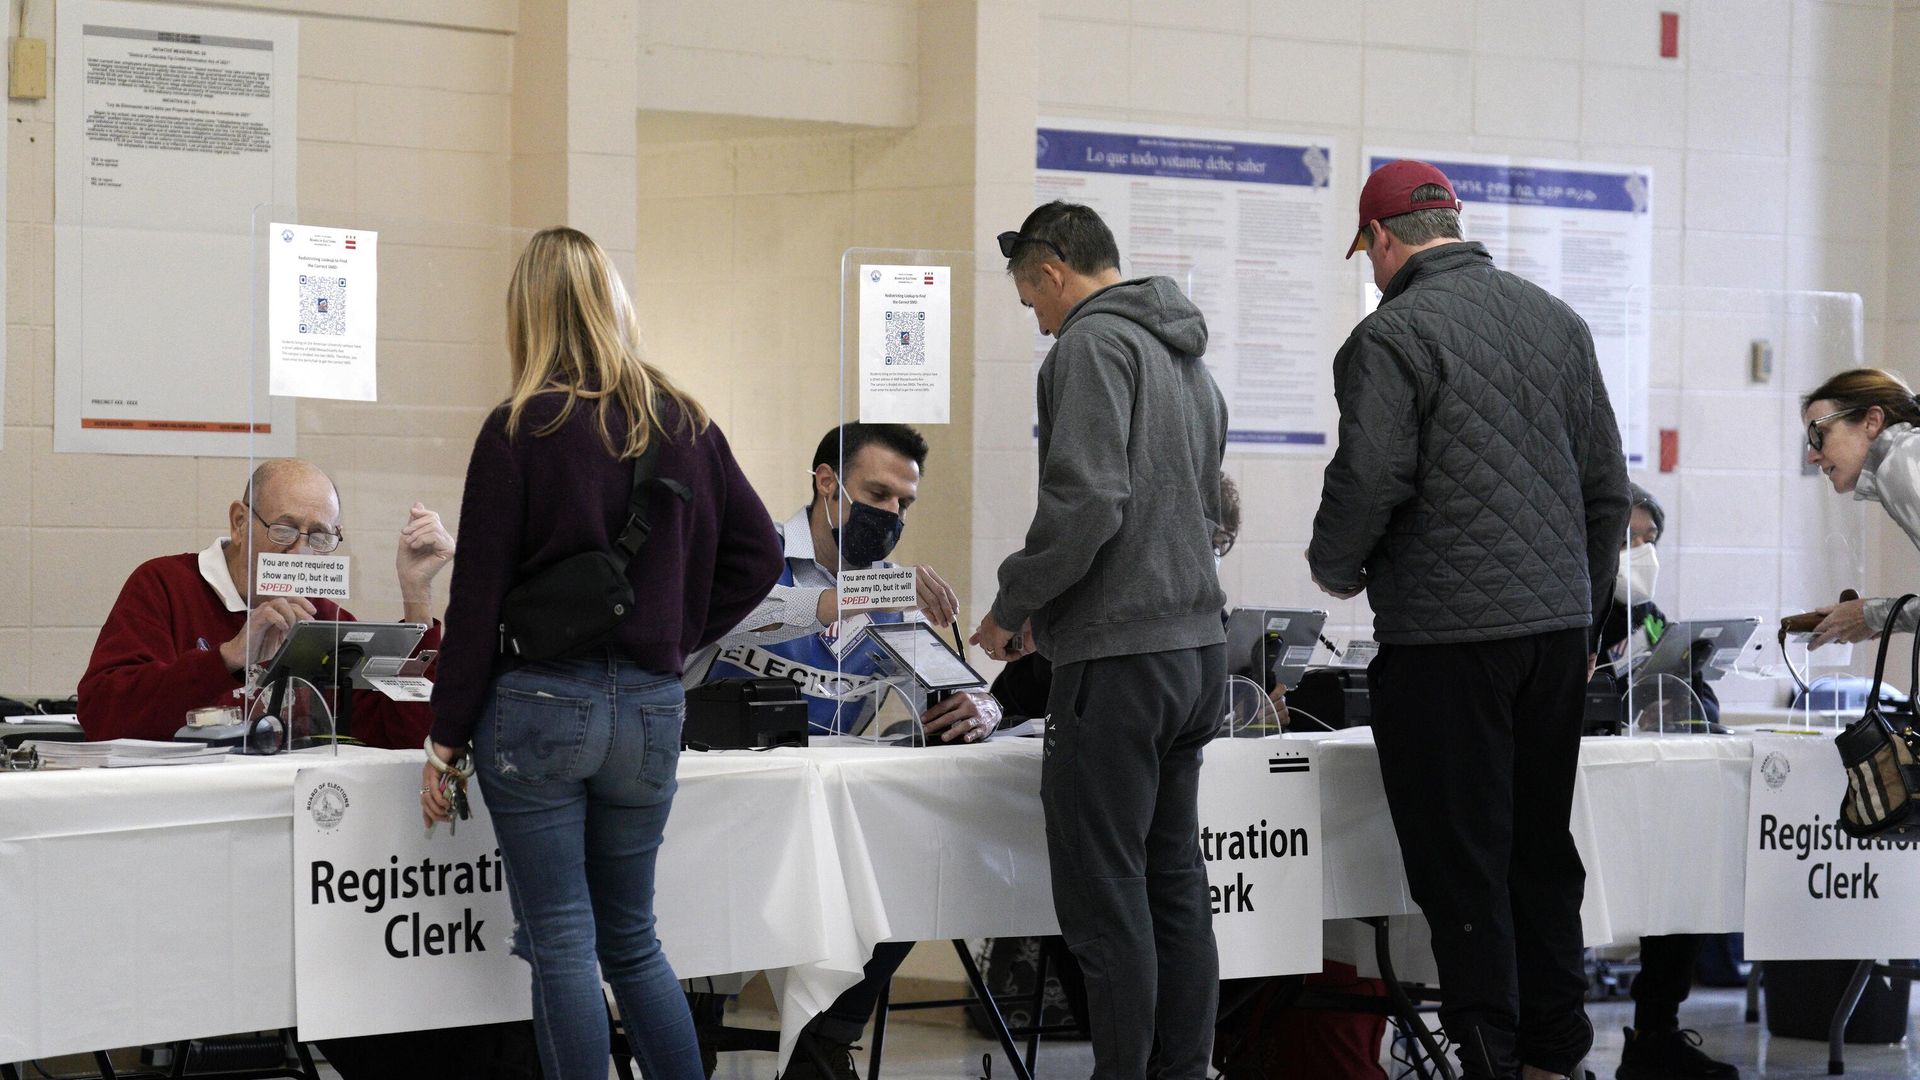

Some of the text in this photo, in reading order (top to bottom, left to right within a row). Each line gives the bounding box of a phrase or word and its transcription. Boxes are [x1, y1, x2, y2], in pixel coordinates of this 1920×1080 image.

[1107, 150, 1128, 167] que
[1130, 150, 1157, 166] todo
[1161, 154, 1202, 170] votante
[1205, 154, 1233, 172] debe
[1237, 158, 1266, 174] saber
[262, 558, 275, 566] You
[305, 561, 334, 570] required
[262, 571, 343, 582] show any ID, but it will
[879, 572, 904, 580] required
[259, 583, 292, 592] SPEED
[841, 596, 869, 605] SPEED
[307, 788, 318, 810] BOARD
[327, 782, 349, 808] ELECTIONS
[1201, 819, 1308, 862] tration
[312, 848, 502, 913] Registrati
[1210, 872, 1254, 914] erk
[1808, 862, 1879, 899] Clerk
[384, 908, 486, 958] Clerk
